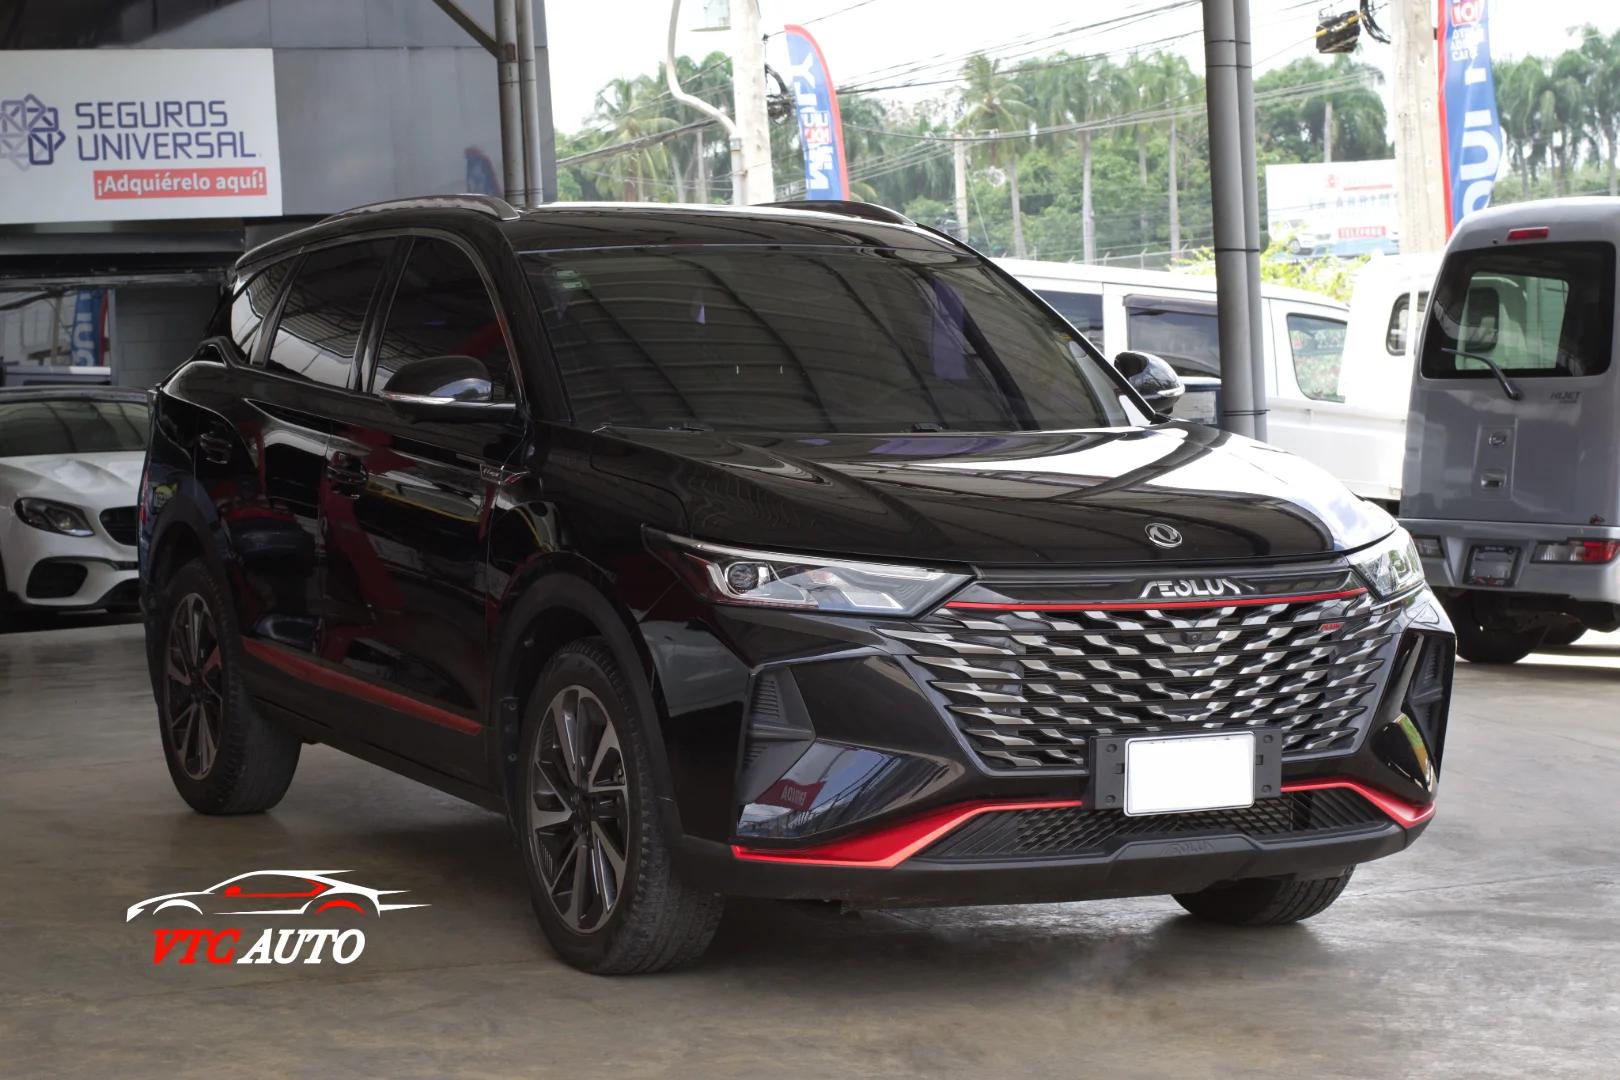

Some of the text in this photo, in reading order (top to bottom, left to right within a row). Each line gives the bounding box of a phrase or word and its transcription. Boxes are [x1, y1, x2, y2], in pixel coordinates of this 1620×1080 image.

[75, 100, 228, 130] SEGUROS
[77, 131, 257, 161] UNIVERSAL
[97, 169, 264, 196] ¡Adquiérelo aquí!
